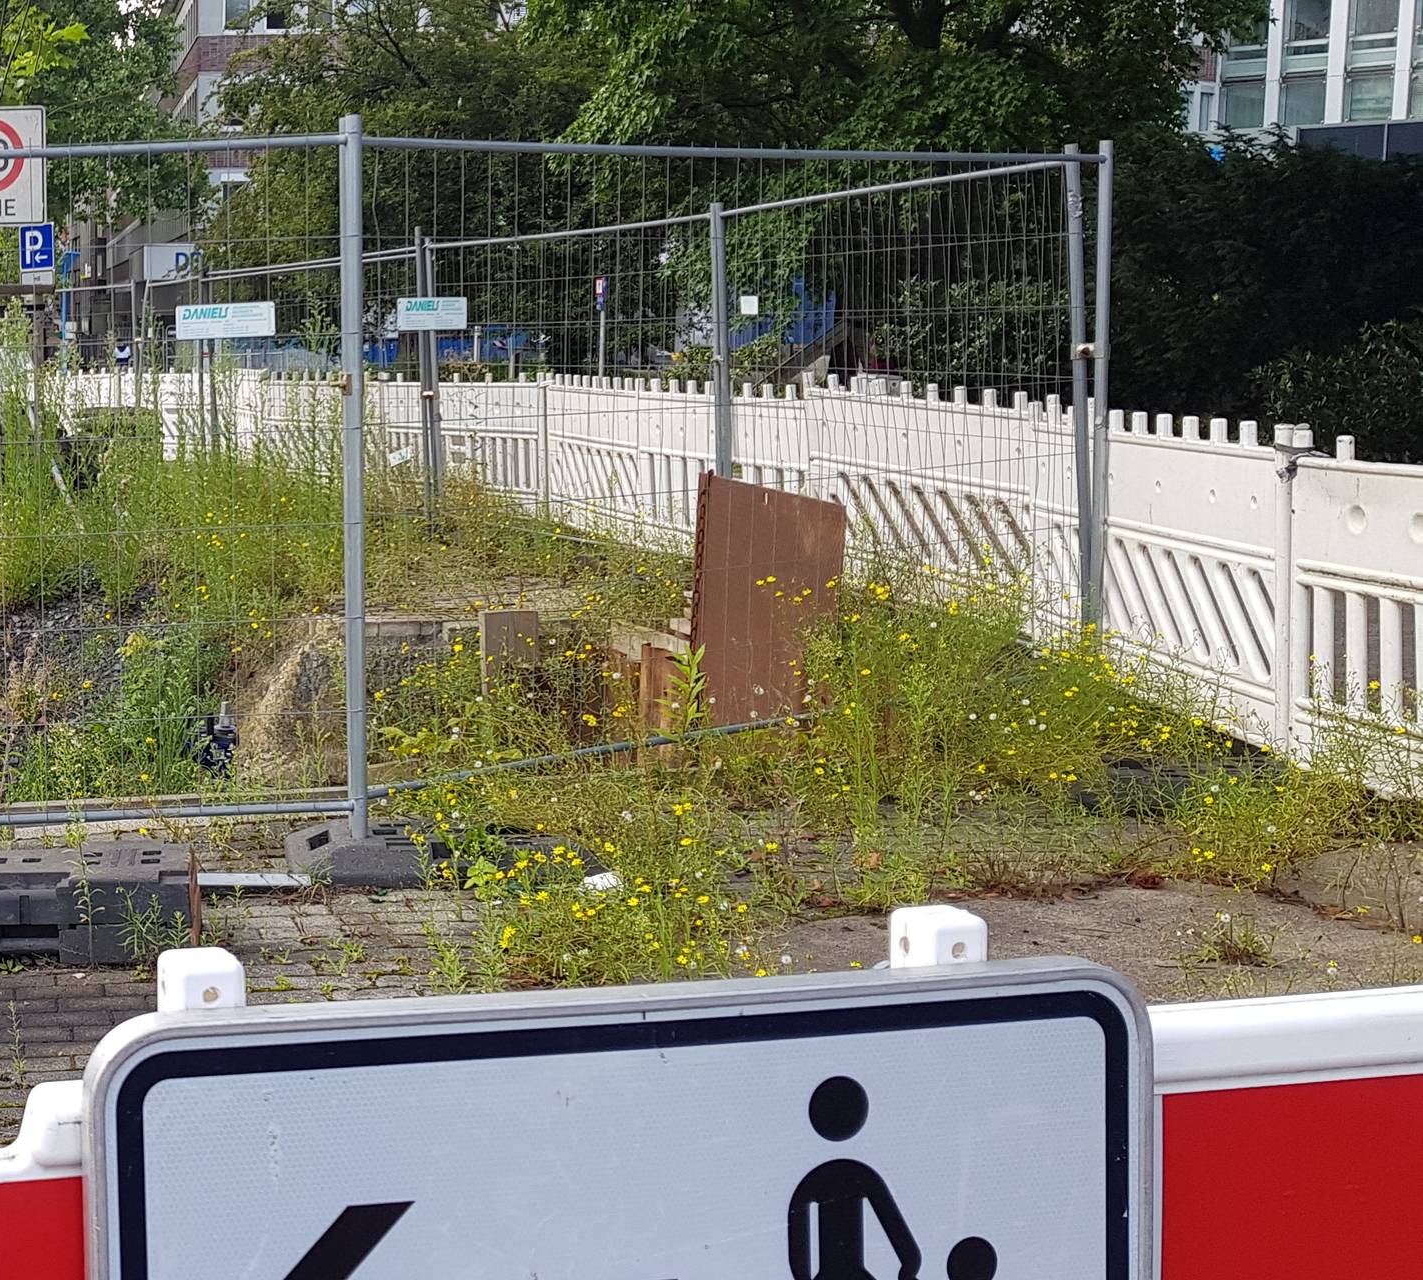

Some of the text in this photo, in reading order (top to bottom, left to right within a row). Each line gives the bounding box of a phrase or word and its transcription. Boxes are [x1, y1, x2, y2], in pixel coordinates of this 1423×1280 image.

[25, 230, 44, 265] P
[182, 306, 230, 320] DANIELS
[405, 300, 440, 312] DANIELS
